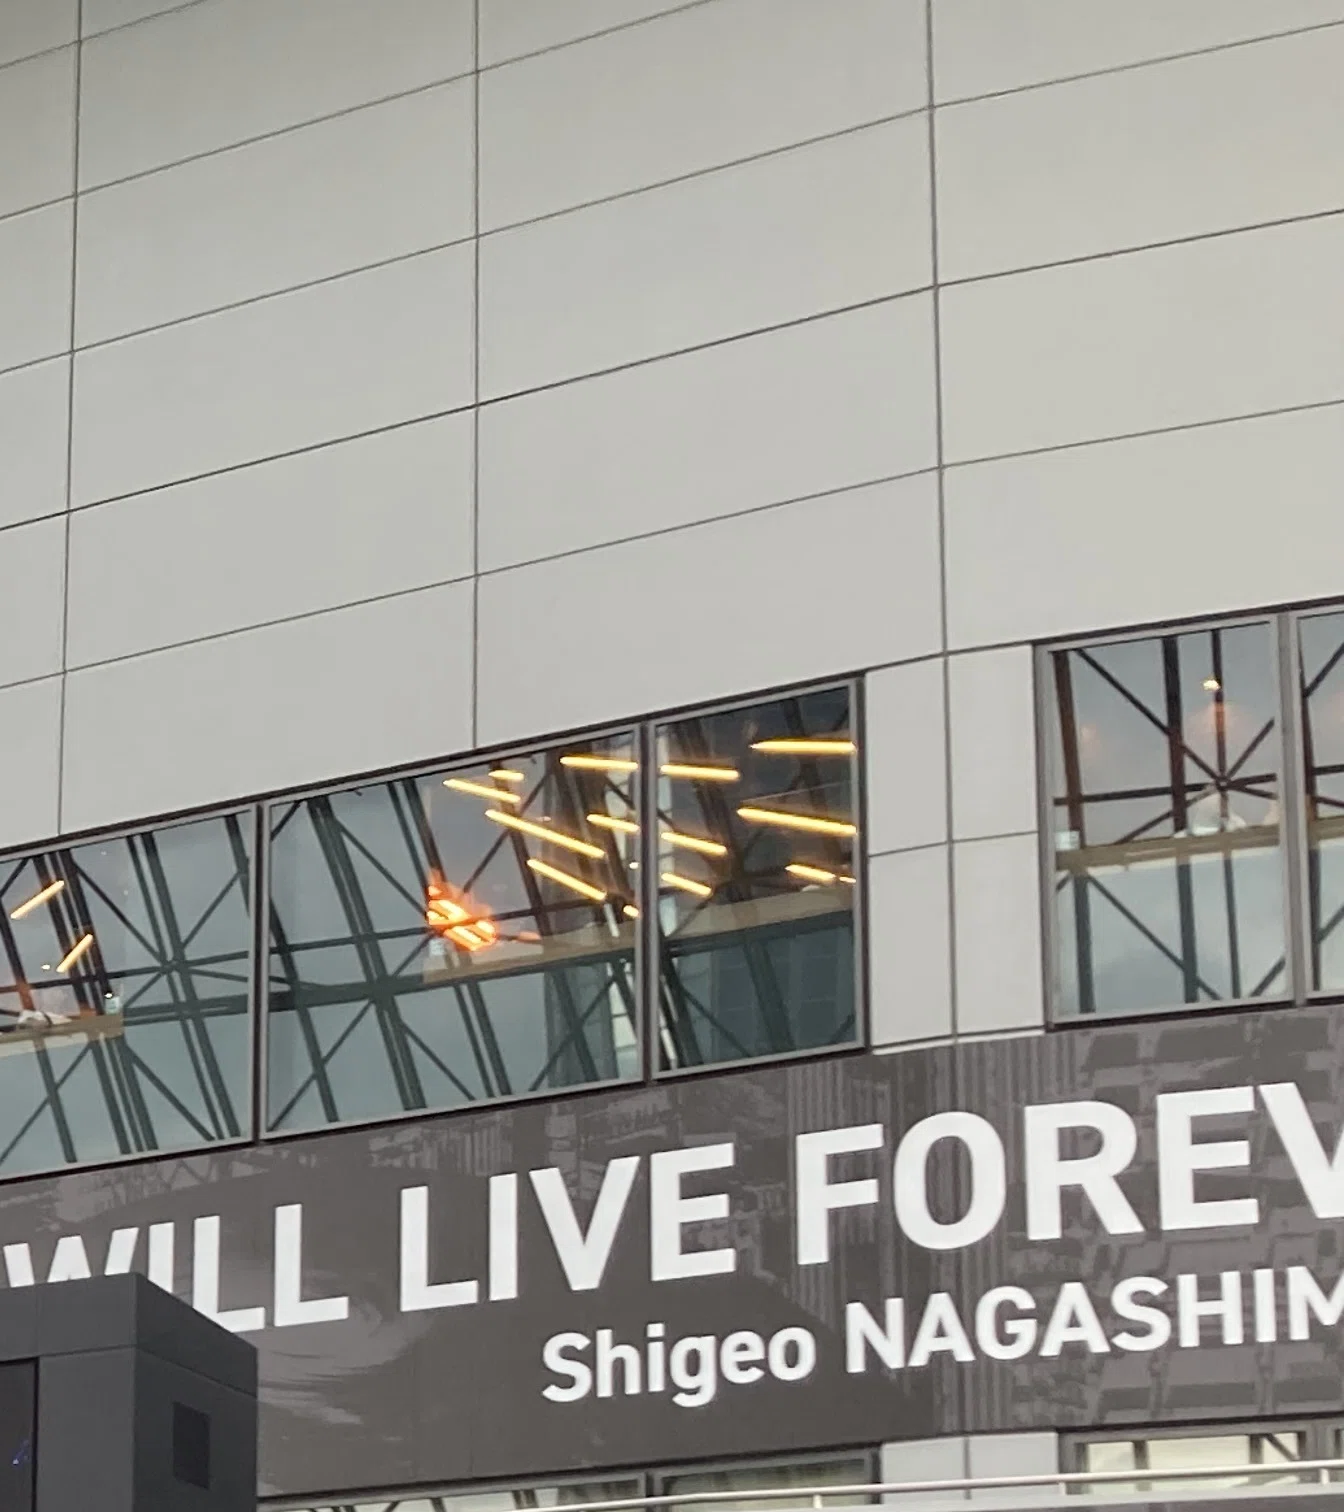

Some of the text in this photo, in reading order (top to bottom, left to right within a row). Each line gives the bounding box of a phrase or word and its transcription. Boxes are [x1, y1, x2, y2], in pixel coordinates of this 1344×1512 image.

[400, 1142, 737, 1312] LIVE
[796, 1082, 1344, 1266] FOREV
[542, 1265, 1344, 1408] Shigeo NAGASHIM
